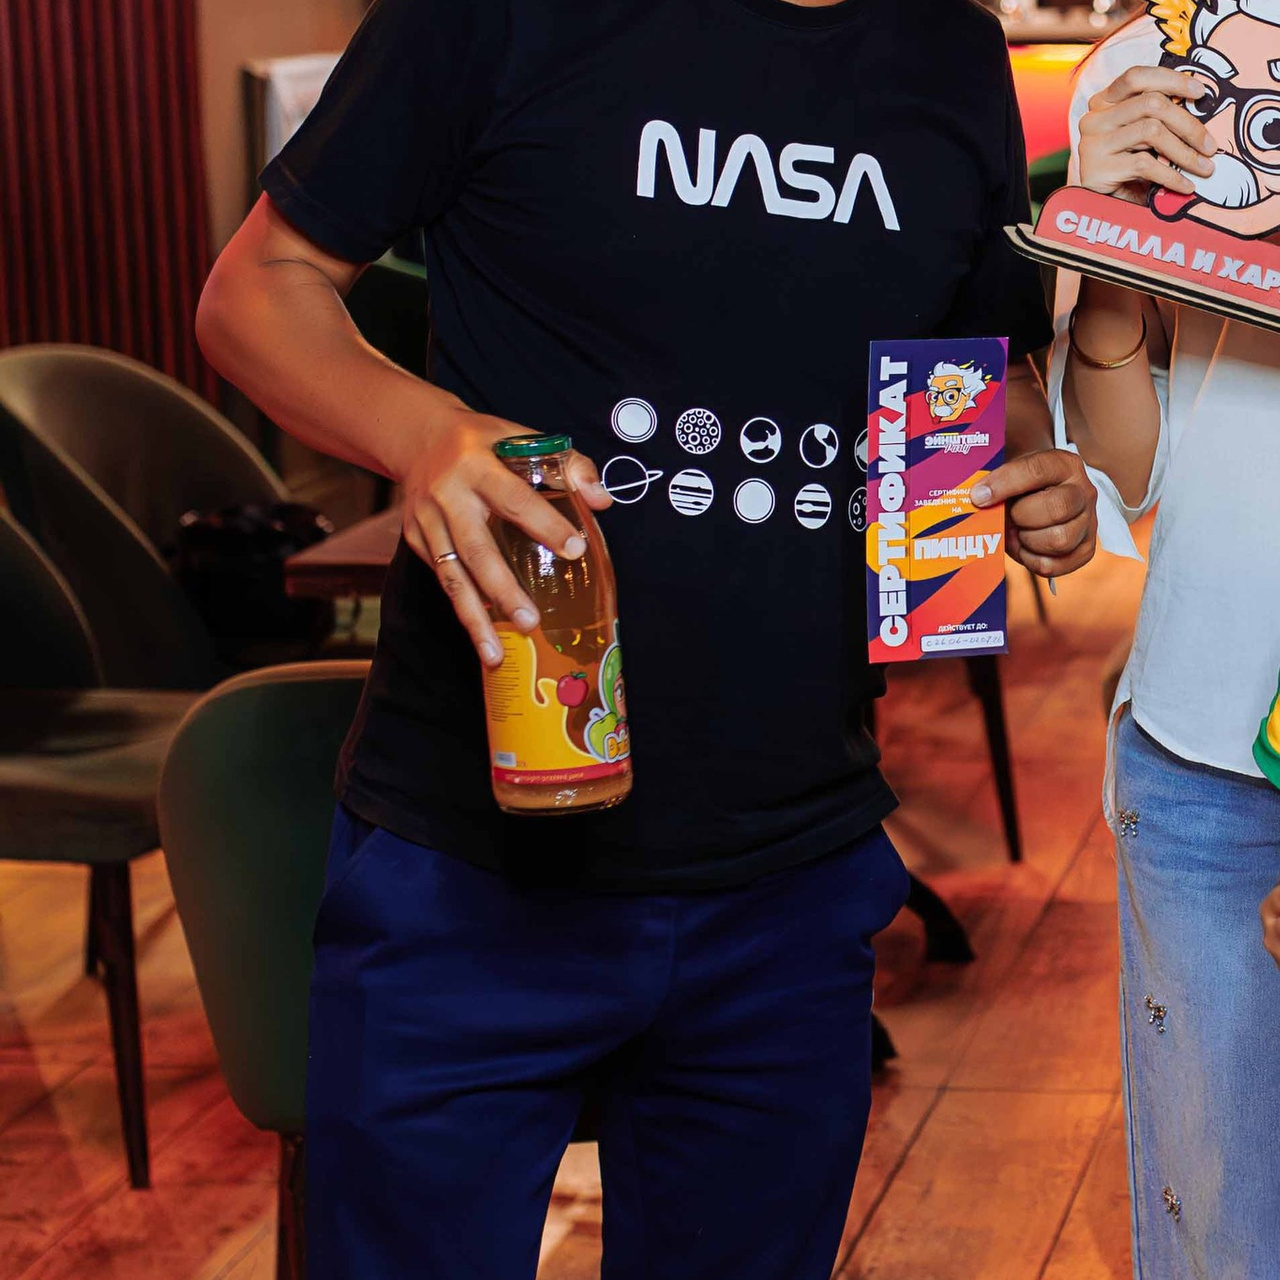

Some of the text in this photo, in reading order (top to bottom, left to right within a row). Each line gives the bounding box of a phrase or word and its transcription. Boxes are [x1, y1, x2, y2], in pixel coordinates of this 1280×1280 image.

[636, 119, 901, 232] NASA
[1055, 210, 1186, 268] СЦИЛЛА
[1190, 249, 1217, 274] И
[878, 355, 909, 648] СЕРТИФИКАТ
[914, 533, 1002, 560] ПИЦЦУ
